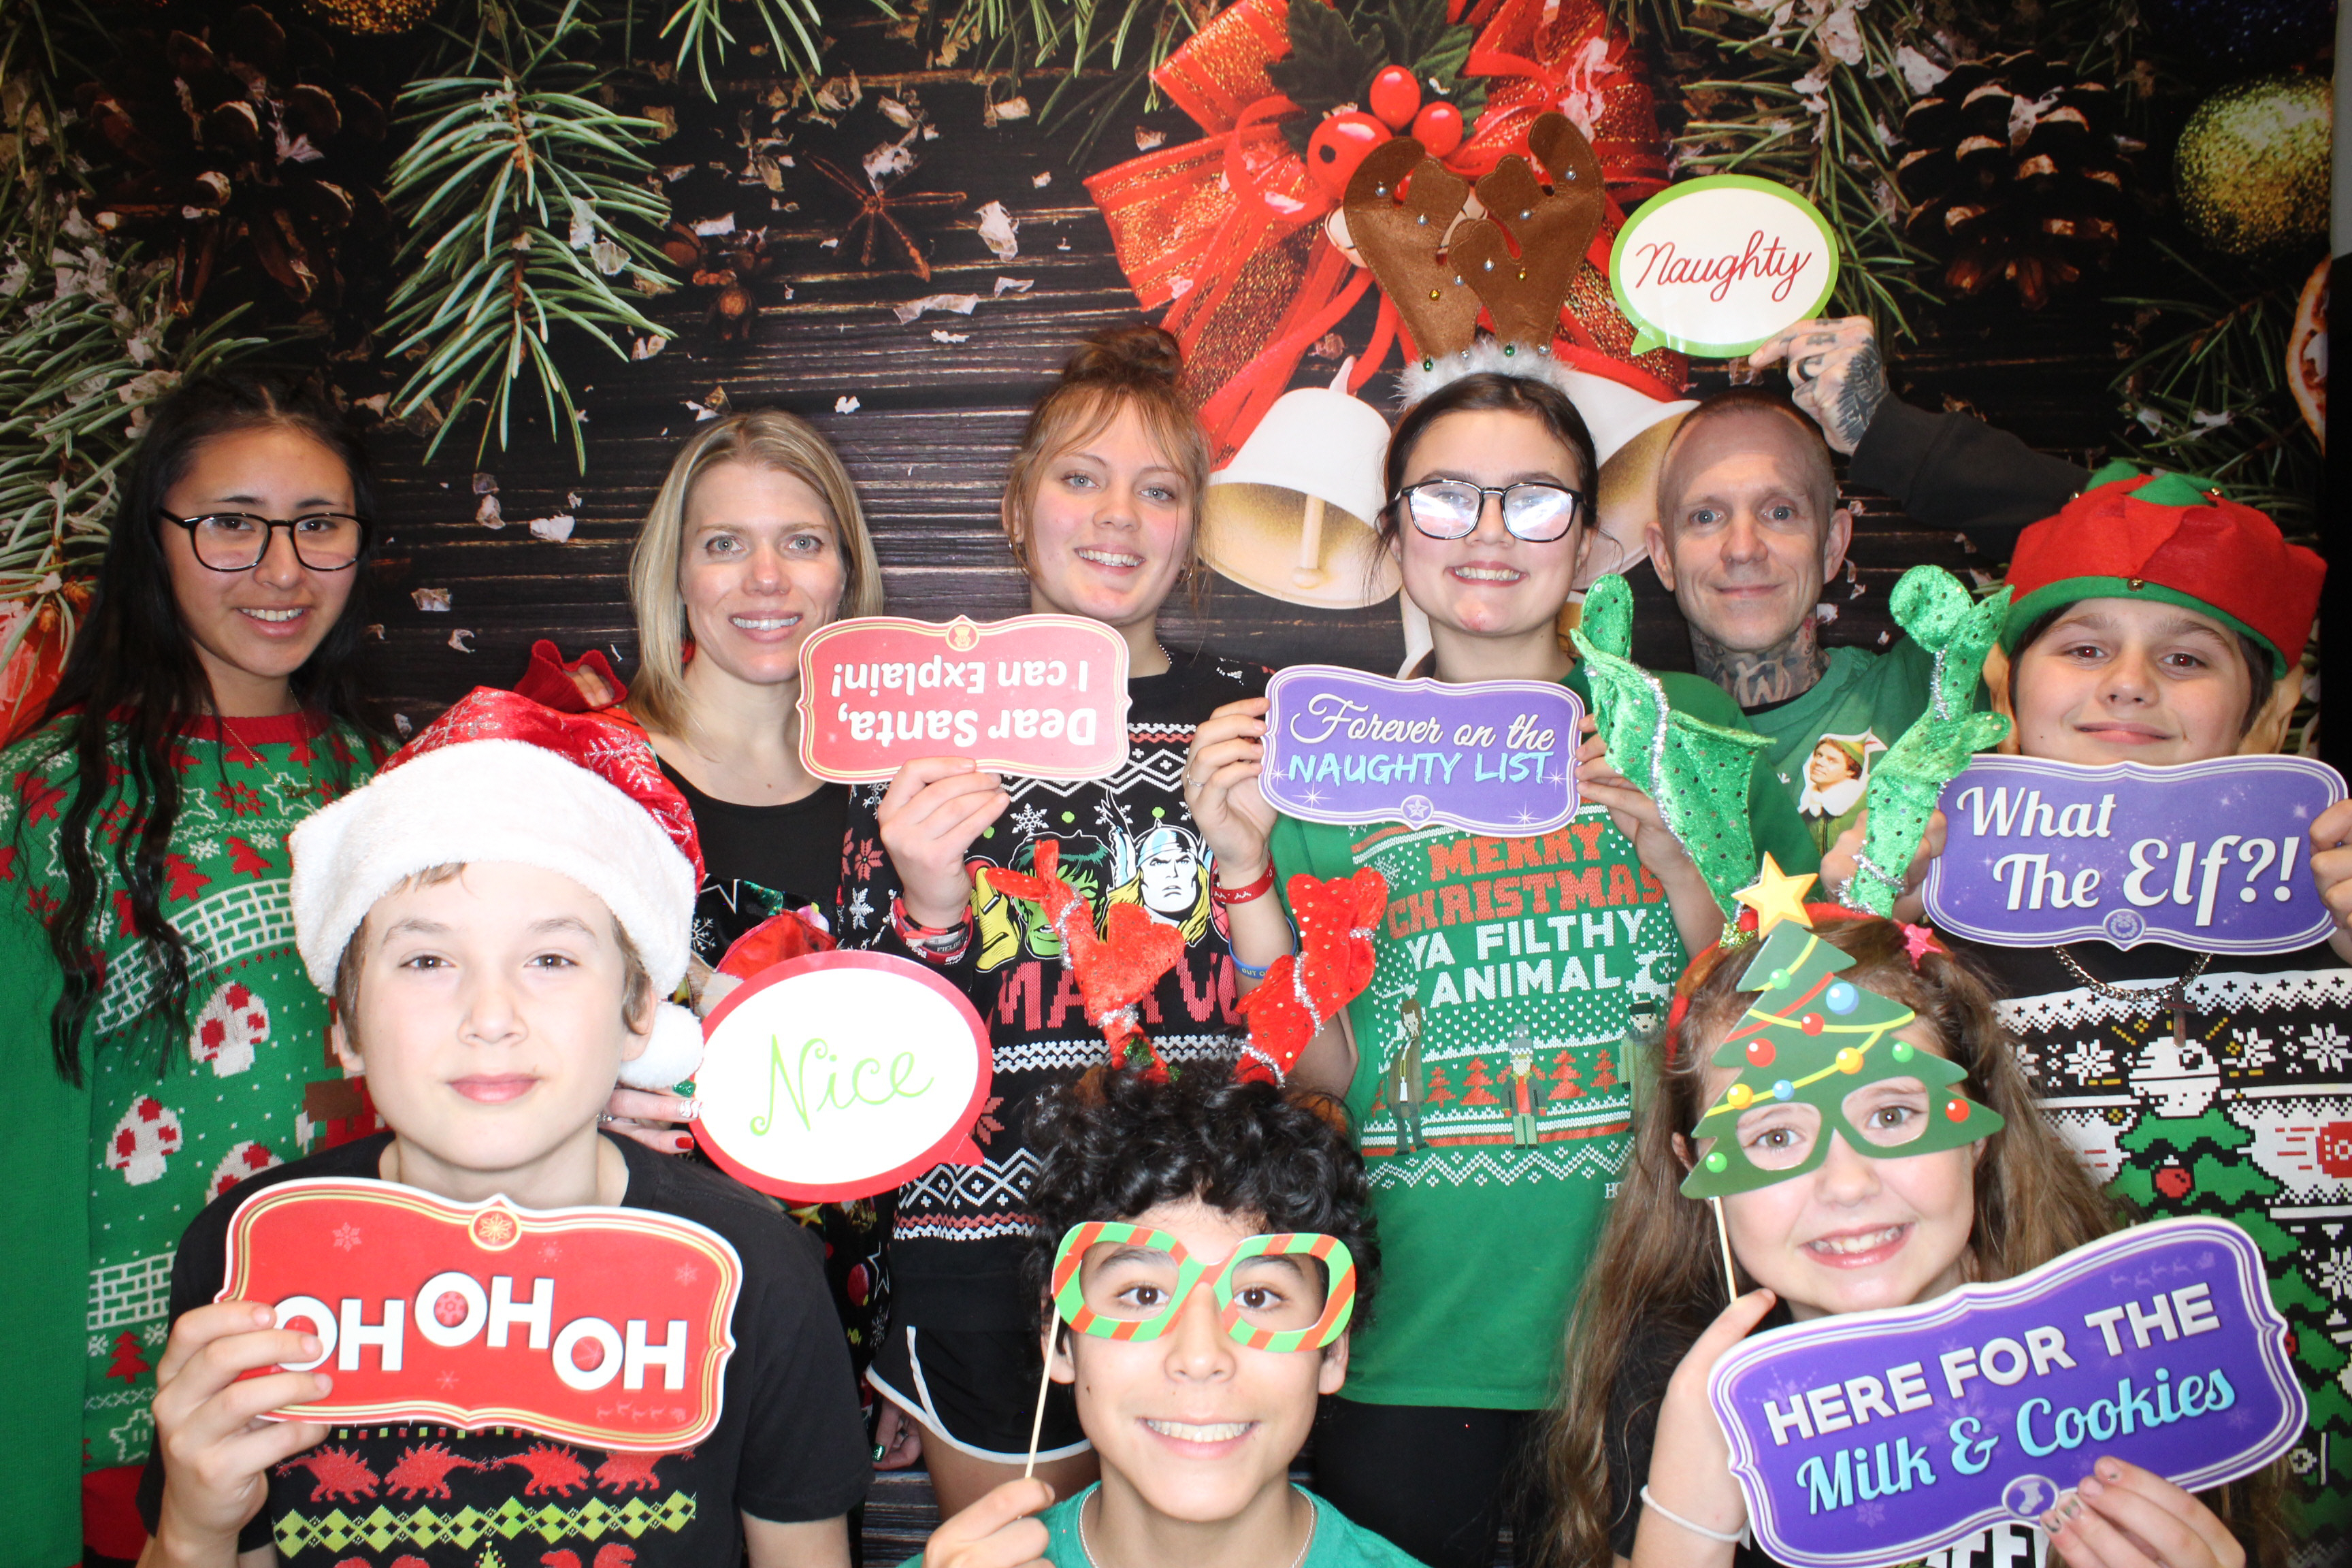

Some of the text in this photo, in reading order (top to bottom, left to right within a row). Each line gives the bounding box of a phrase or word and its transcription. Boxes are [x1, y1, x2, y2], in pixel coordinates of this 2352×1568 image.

[1636, 230, 1812, 302] Naughty
[832, 655, 1088, 697] I can Explain!
[837, 702, 1096, 747] Dear Santa,
[1290, 693, 1556, 751] Forever on the
[1288, 751, 1554, 786] NAUGHTY LIST
[1956, 786, 2117, 838] What
[1428, 821, 1604, 881] MERRY
[1993, 835, 2300, 926] The Elf?!
[1386, 864, 1664, 940] CHRISTMAS
[1405, 909, 1647, 972] YA FILTHY
[1241, 968, 1256, 976] OUT
[1430, 954, 1621, 1008] ANIMAL
[750, 1034, 934, 1136] Nice
[273, 1271, 687, 1391] OH OH OH
[1763, 1282, 2220, 1446] HERE FOR THE
[1796, 1367, 2236, 1516] Milk & Cookies
